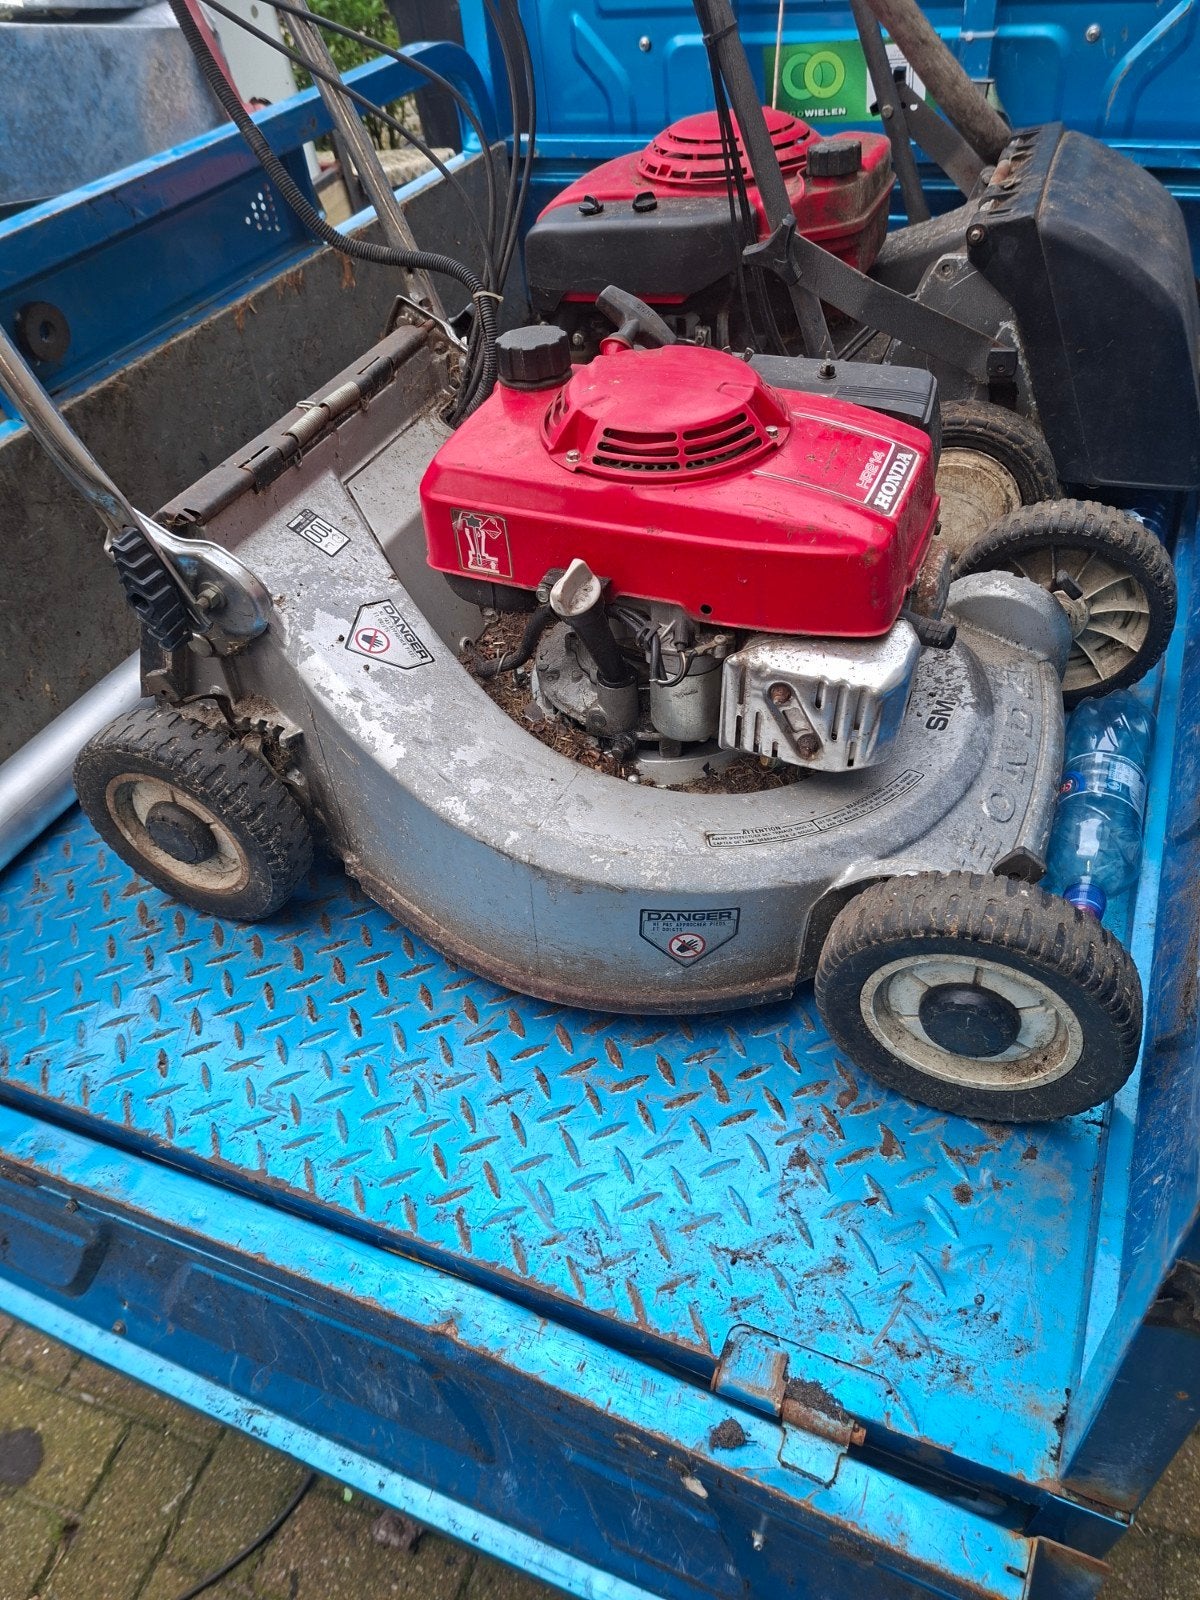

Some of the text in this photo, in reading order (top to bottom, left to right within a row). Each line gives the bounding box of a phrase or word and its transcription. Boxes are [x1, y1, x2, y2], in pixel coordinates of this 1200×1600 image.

[873, 452, 914, 510] HONDA
[304, 521, 333, 544] 100
[383, 605, 429, 660] DANGER
[925, 699, 957, 732] SM
[742, 826, 781, 835] ATTENTION
[647, 911, 732, 921] DANGER
